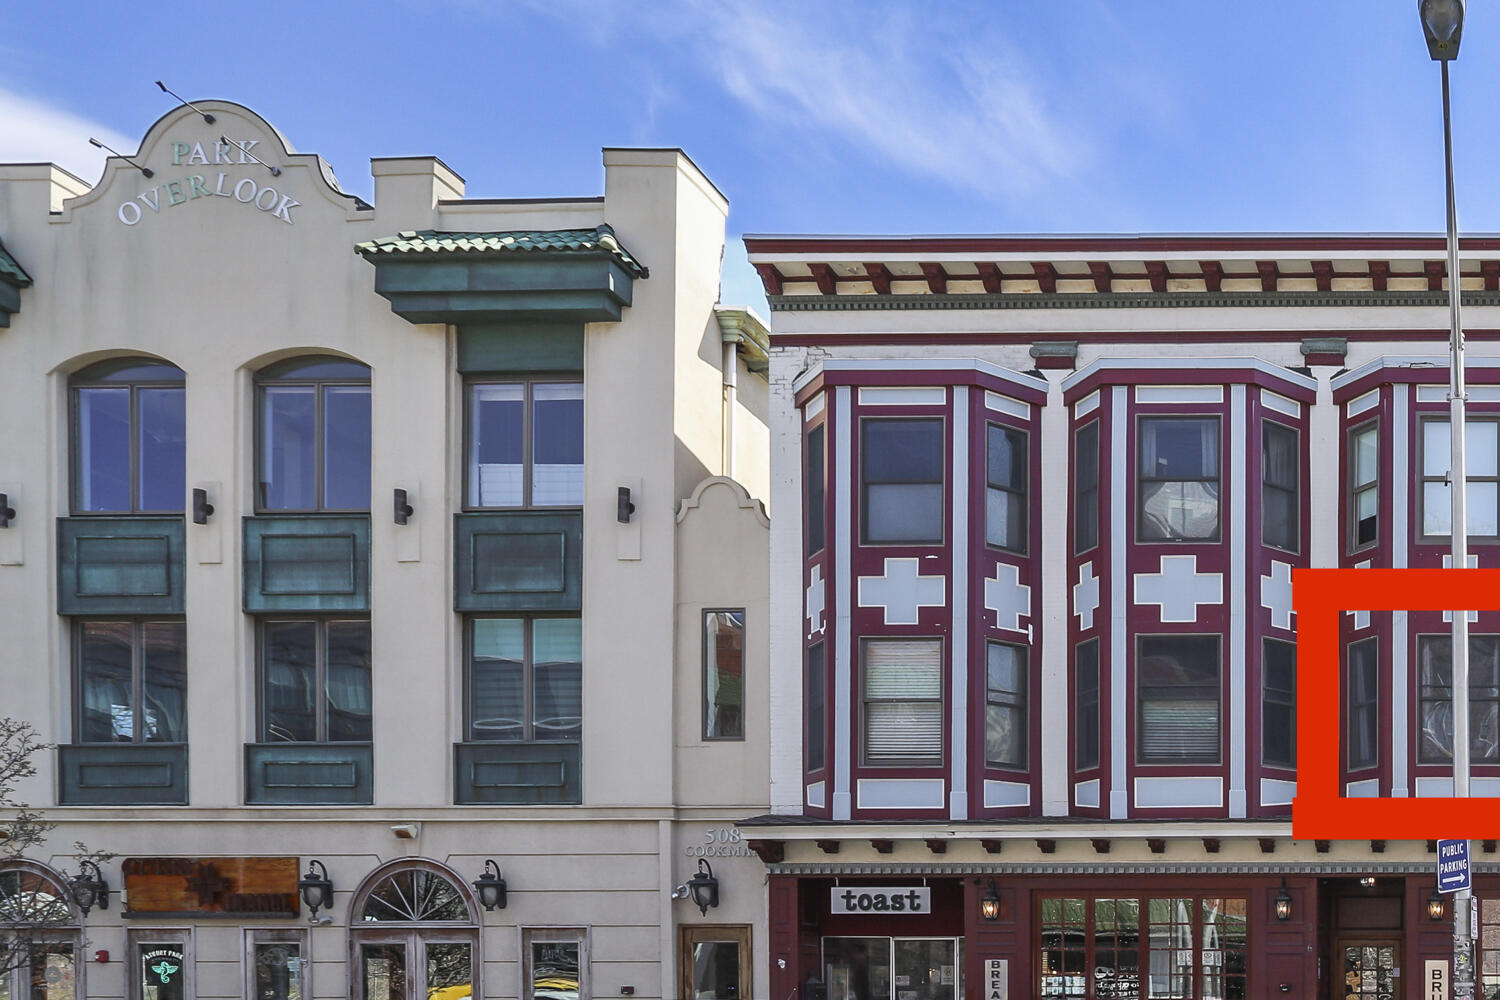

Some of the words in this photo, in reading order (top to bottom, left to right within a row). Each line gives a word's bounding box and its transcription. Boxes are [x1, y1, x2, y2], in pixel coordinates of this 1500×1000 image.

[171, 140, 260, 166] PARK
[118, 172, 301, 226] OVERLOOK
[705, 828, 741, 844] 508
[1442, 843, 1464, 858] PUBLIC
[1440, 859, 1468, 874] PARKING
[840, 890, 921, 911] toast
